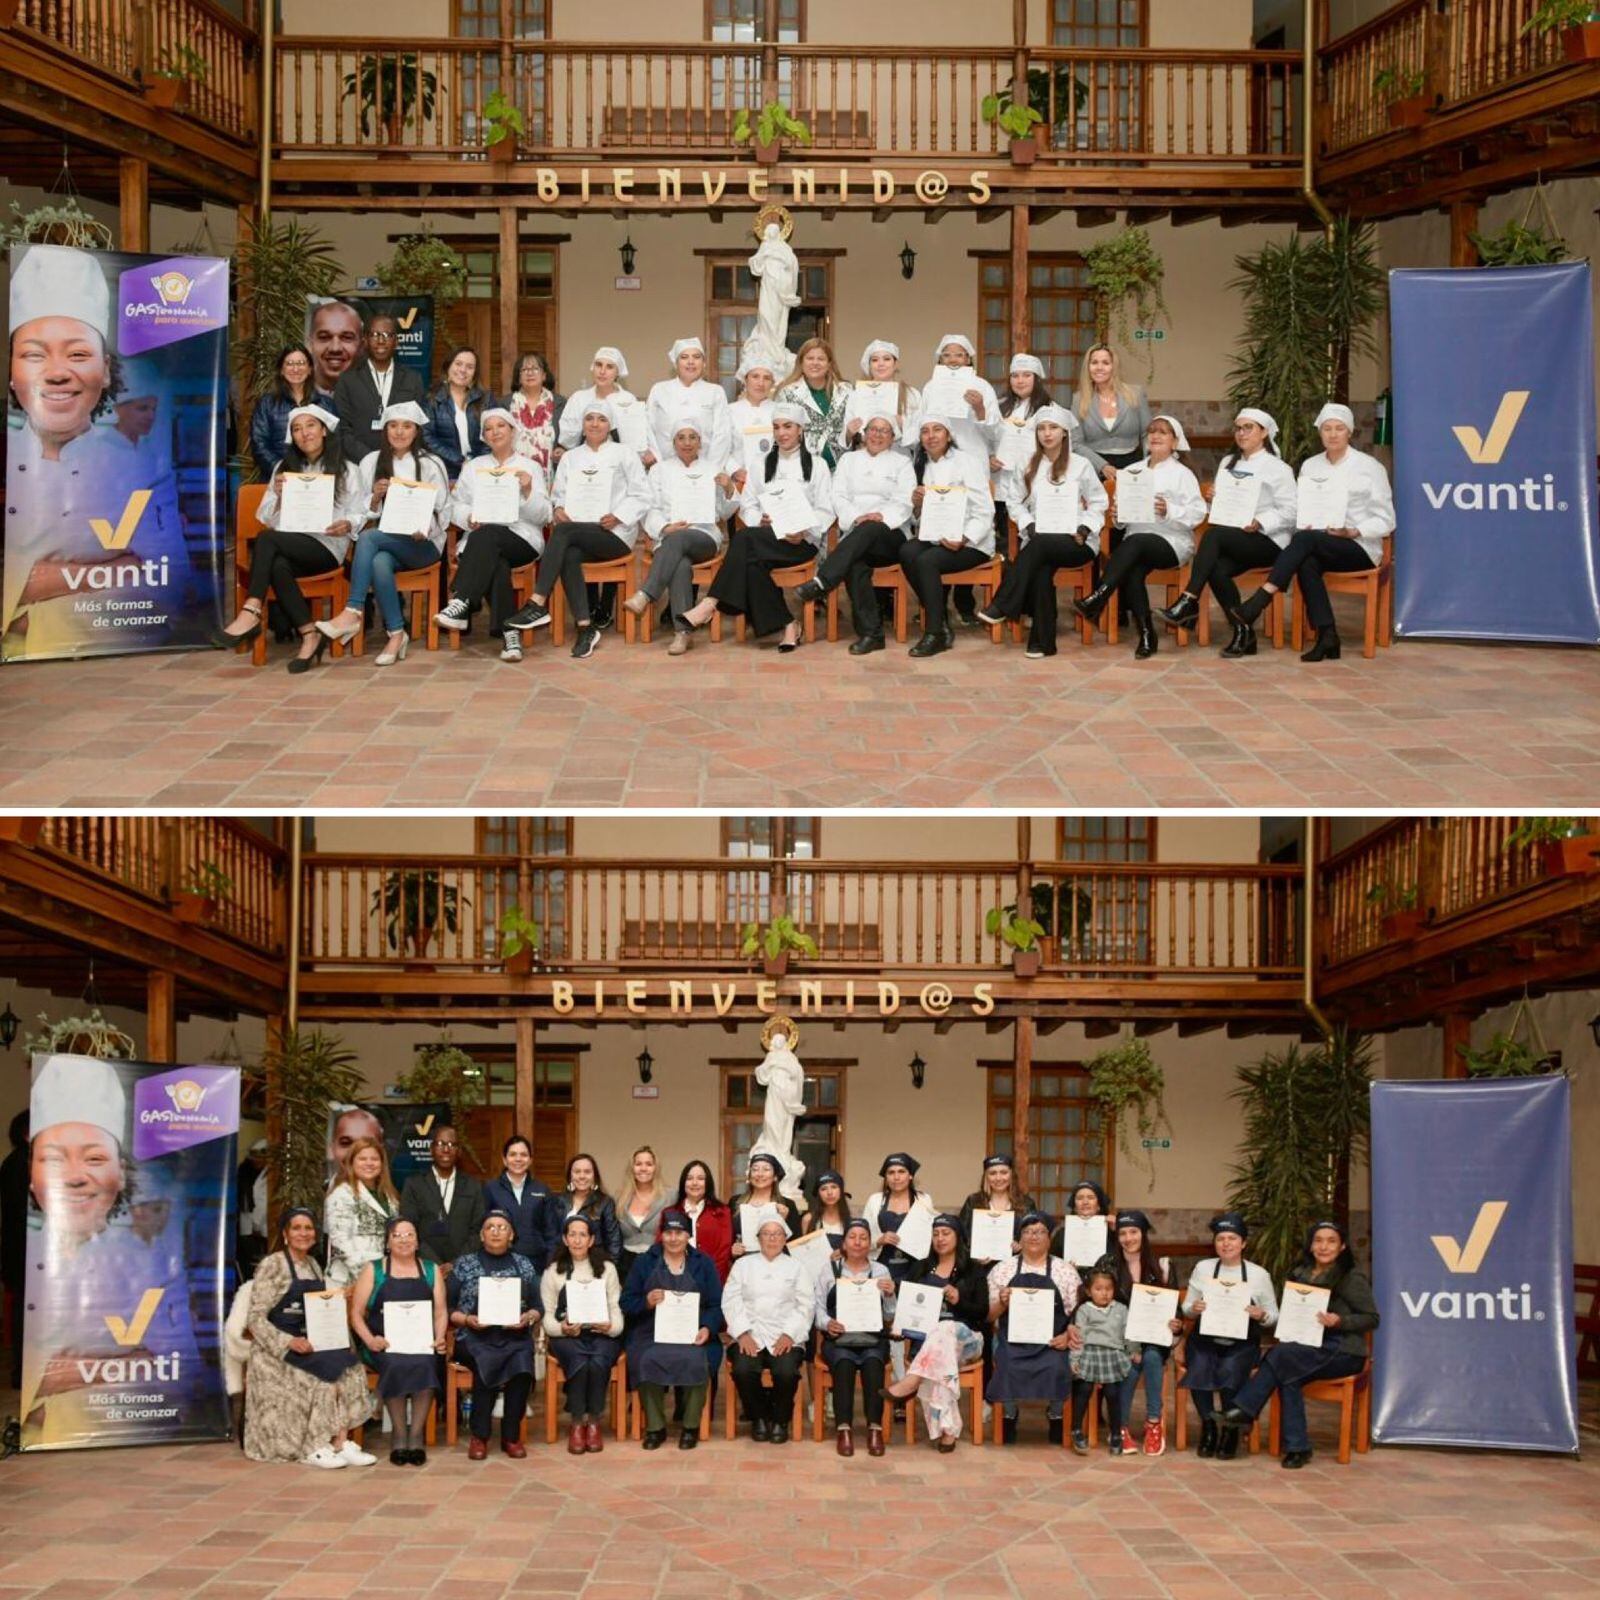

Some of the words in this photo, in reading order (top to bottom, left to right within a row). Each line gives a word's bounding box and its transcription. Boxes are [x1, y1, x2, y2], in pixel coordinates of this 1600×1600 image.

[536, 168, 992, 204] BIENVENID@S
[397, 330, 422, 343] anti
[61, 555, 169, 590] vanti
[74, 601, 102, 612] Más
[106, 600, 153, 610] formas
[92, 617, 110, 627] de
[113, 615, 168, 626] avanzar
[552, 981, 994, 1015] BIENVENID@S
[78, 1351, 180, 1383] vanti
[88, 1393, 116, 1404] Más
[119, 1393, 164, 1404] formas
[106, 1409, 122, 1419] de
[125, 1408, 179, 1418] avanzar
